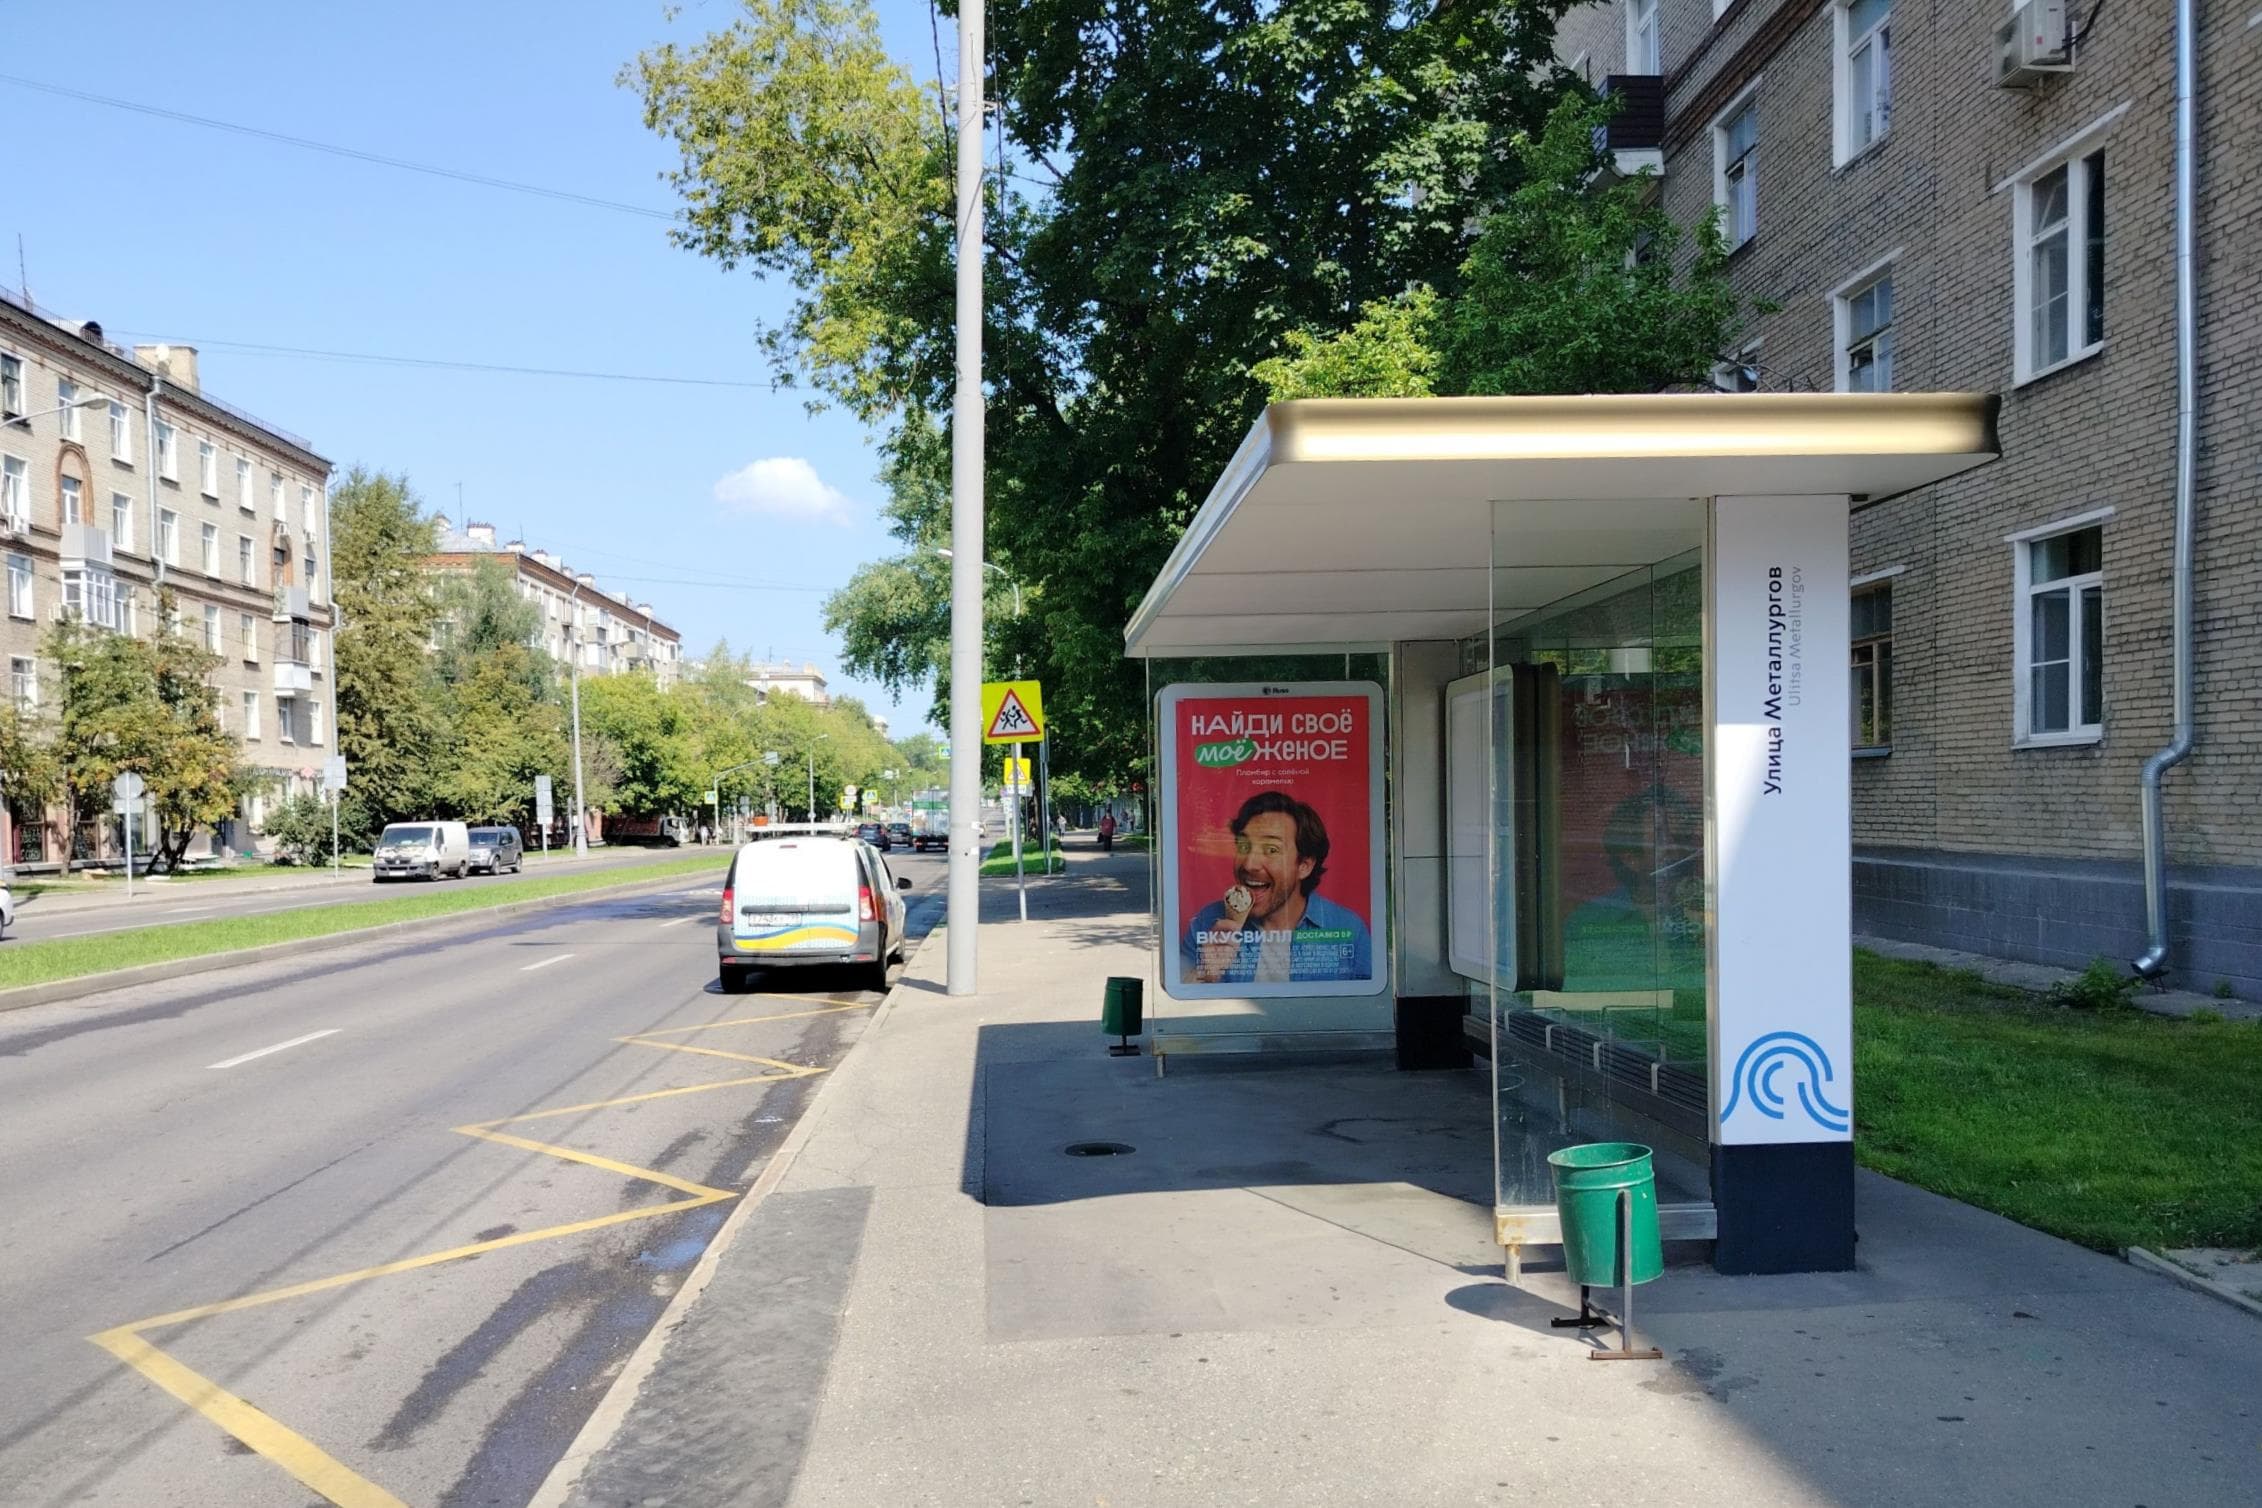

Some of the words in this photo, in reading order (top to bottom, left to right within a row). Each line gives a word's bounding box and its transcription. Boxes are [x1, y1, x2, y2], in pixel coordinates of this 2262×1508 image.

[1788, 566, 1804, 658] Metallurgov
[1763, 566, 1786, 720] Металлургов
[1789, 662, 1801, 706] Ulitsa
[1191, 710, 1283, 738] НАЙДИ
[1763, 726, 1784, 795] Улица
[1196, 929, 1293, 945] ВКУСВИЛЛ
